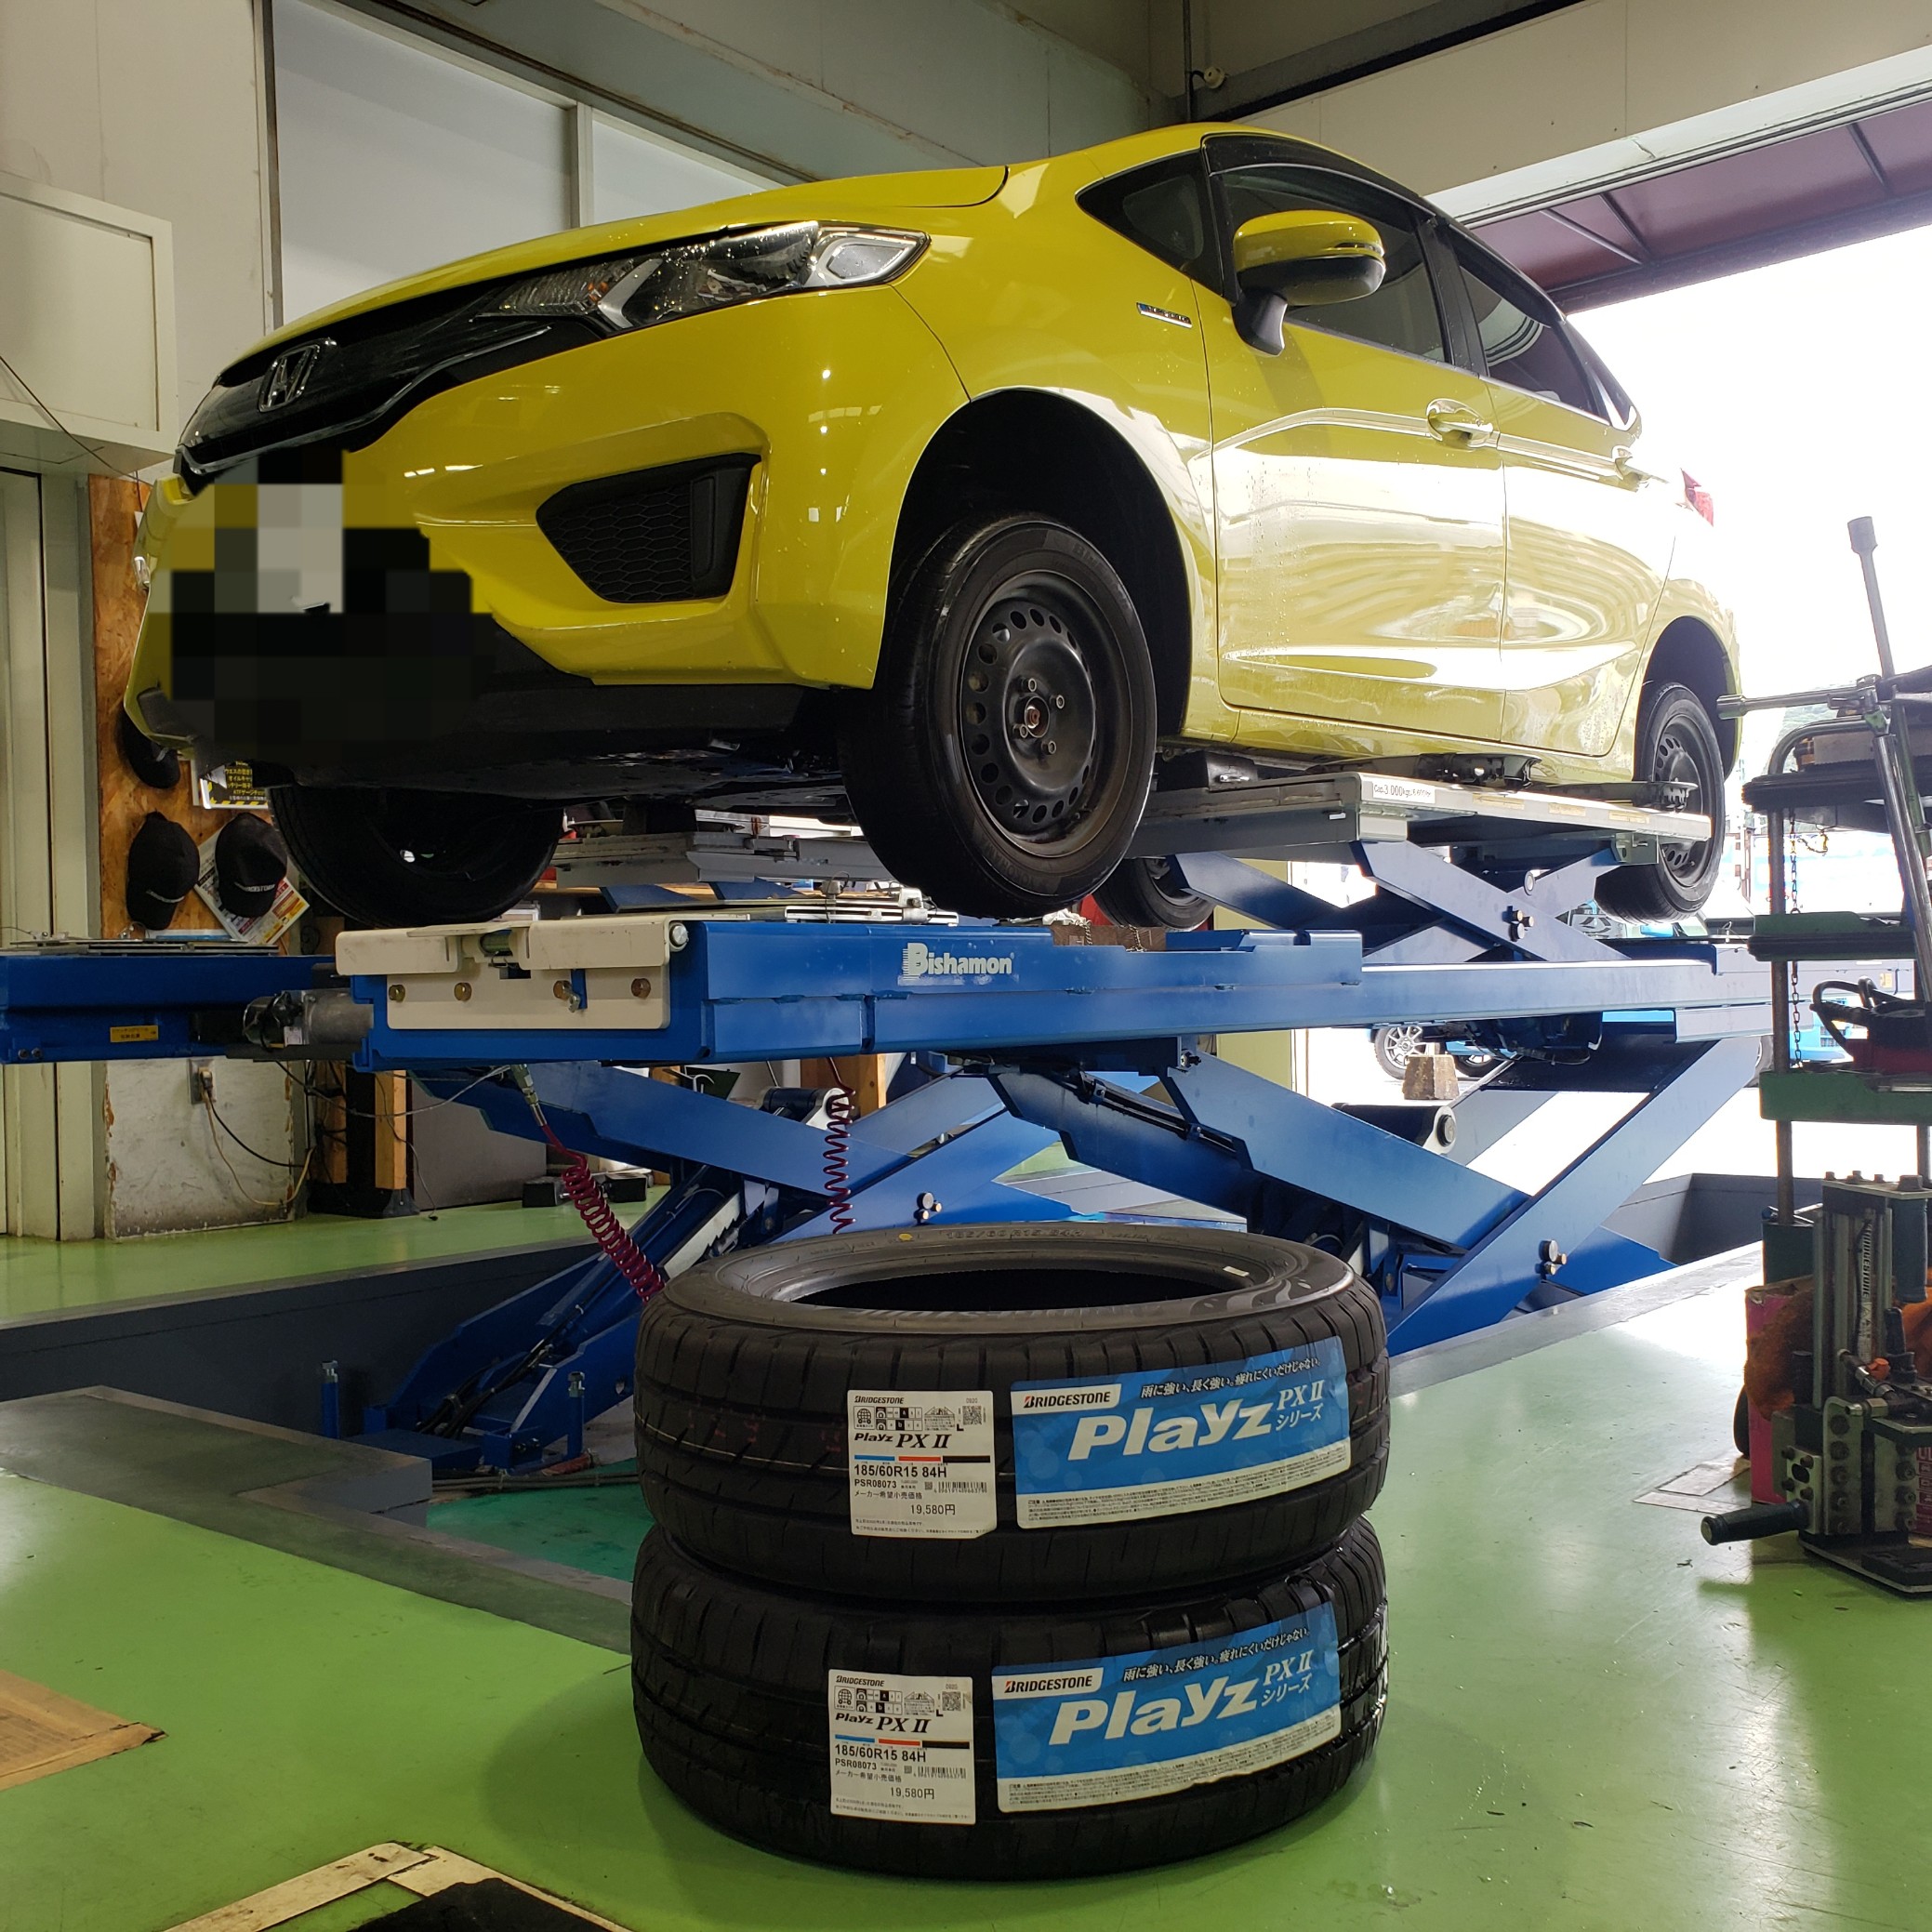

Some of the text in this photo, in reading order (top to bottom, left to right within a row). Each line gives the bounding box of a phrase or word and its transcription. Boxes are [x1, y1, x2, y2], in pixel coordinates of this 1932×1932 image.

[902, 943, 1012, 979] Bishamon
[854, 1396, 904, 1404] BRIDGESTONE
[1024, 1391, 1111, 1409] BRIDGESTONE
[1067, 1398, 1274, 1461] Playz
[1277, 1385, 1307, 1410] PX
[1276, 1403, 1324, 1431] シリーズ
[854, 1433, 893, 1442] Playz
[895, 1434, 930, 1448] PX
[854, 1464, 946, 1477] 185/60R15 84H
[854, 1479, 897, 1489] PSR08073
[854, 1490, 922, 1500] メーカー希望小売価格
[911, 1503, 956, 1515] 19,580円
[836, 1675, 884, 1687] BRIDGESTONE
[1004, 1674, 1092, 1693] BRIDGESTONE
[1261, 1674, 1313, 1706] シリーズ
[1049, 1678, 1260, 1746] Playz
[1263, 1657, 1296, 1686] PX
[836, 1713, 874, 1724] Playz
[876, 1716, 909, 1732] PX
[835, 1744, 926, 1762] 185/60R15 84H
[835, 1758, 877, 1770] PSR08073
[835, 1770, 902, 1782] メーカー希望小売価格
[891, 1787, 934, 1800] 19,580円
